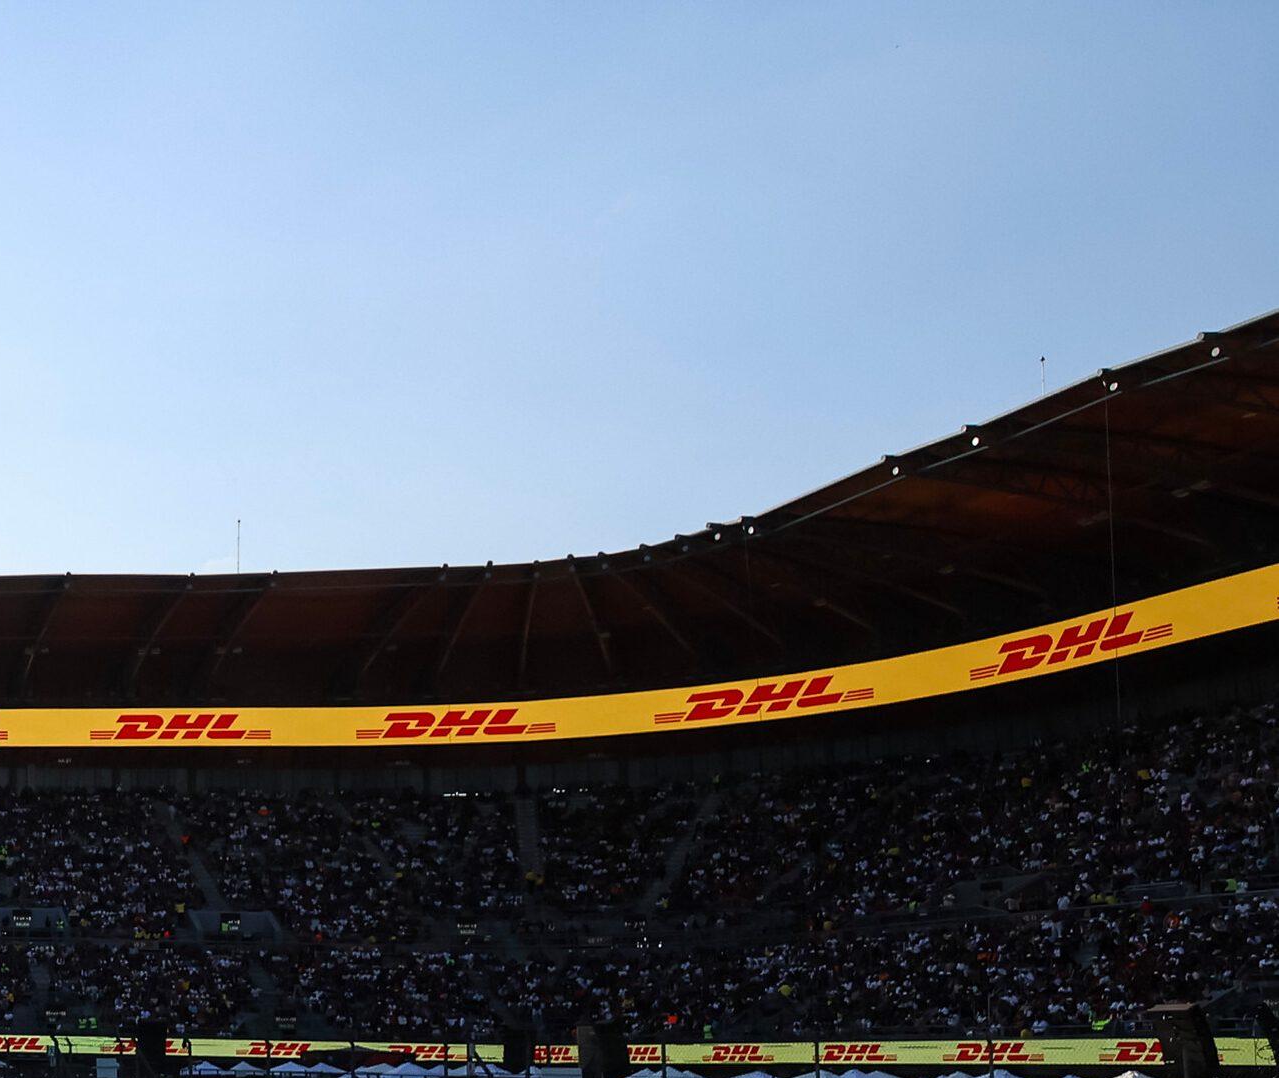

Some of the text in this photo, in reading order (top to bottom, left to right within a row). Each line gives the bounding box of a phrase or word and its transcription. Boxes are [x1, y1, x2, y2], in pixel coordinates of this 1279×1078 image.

[997, 611, 1144, 676] DHL
[684, 675, 843, 722] DHL
[114, 713, 248, 740] DHL
[382, 708, 528, 738] DHL
[712, 1045, 764, 1061] DHL
[823, 1044, 886, 1061] DHL
[956, 1043, 1030, 1061] DHL
